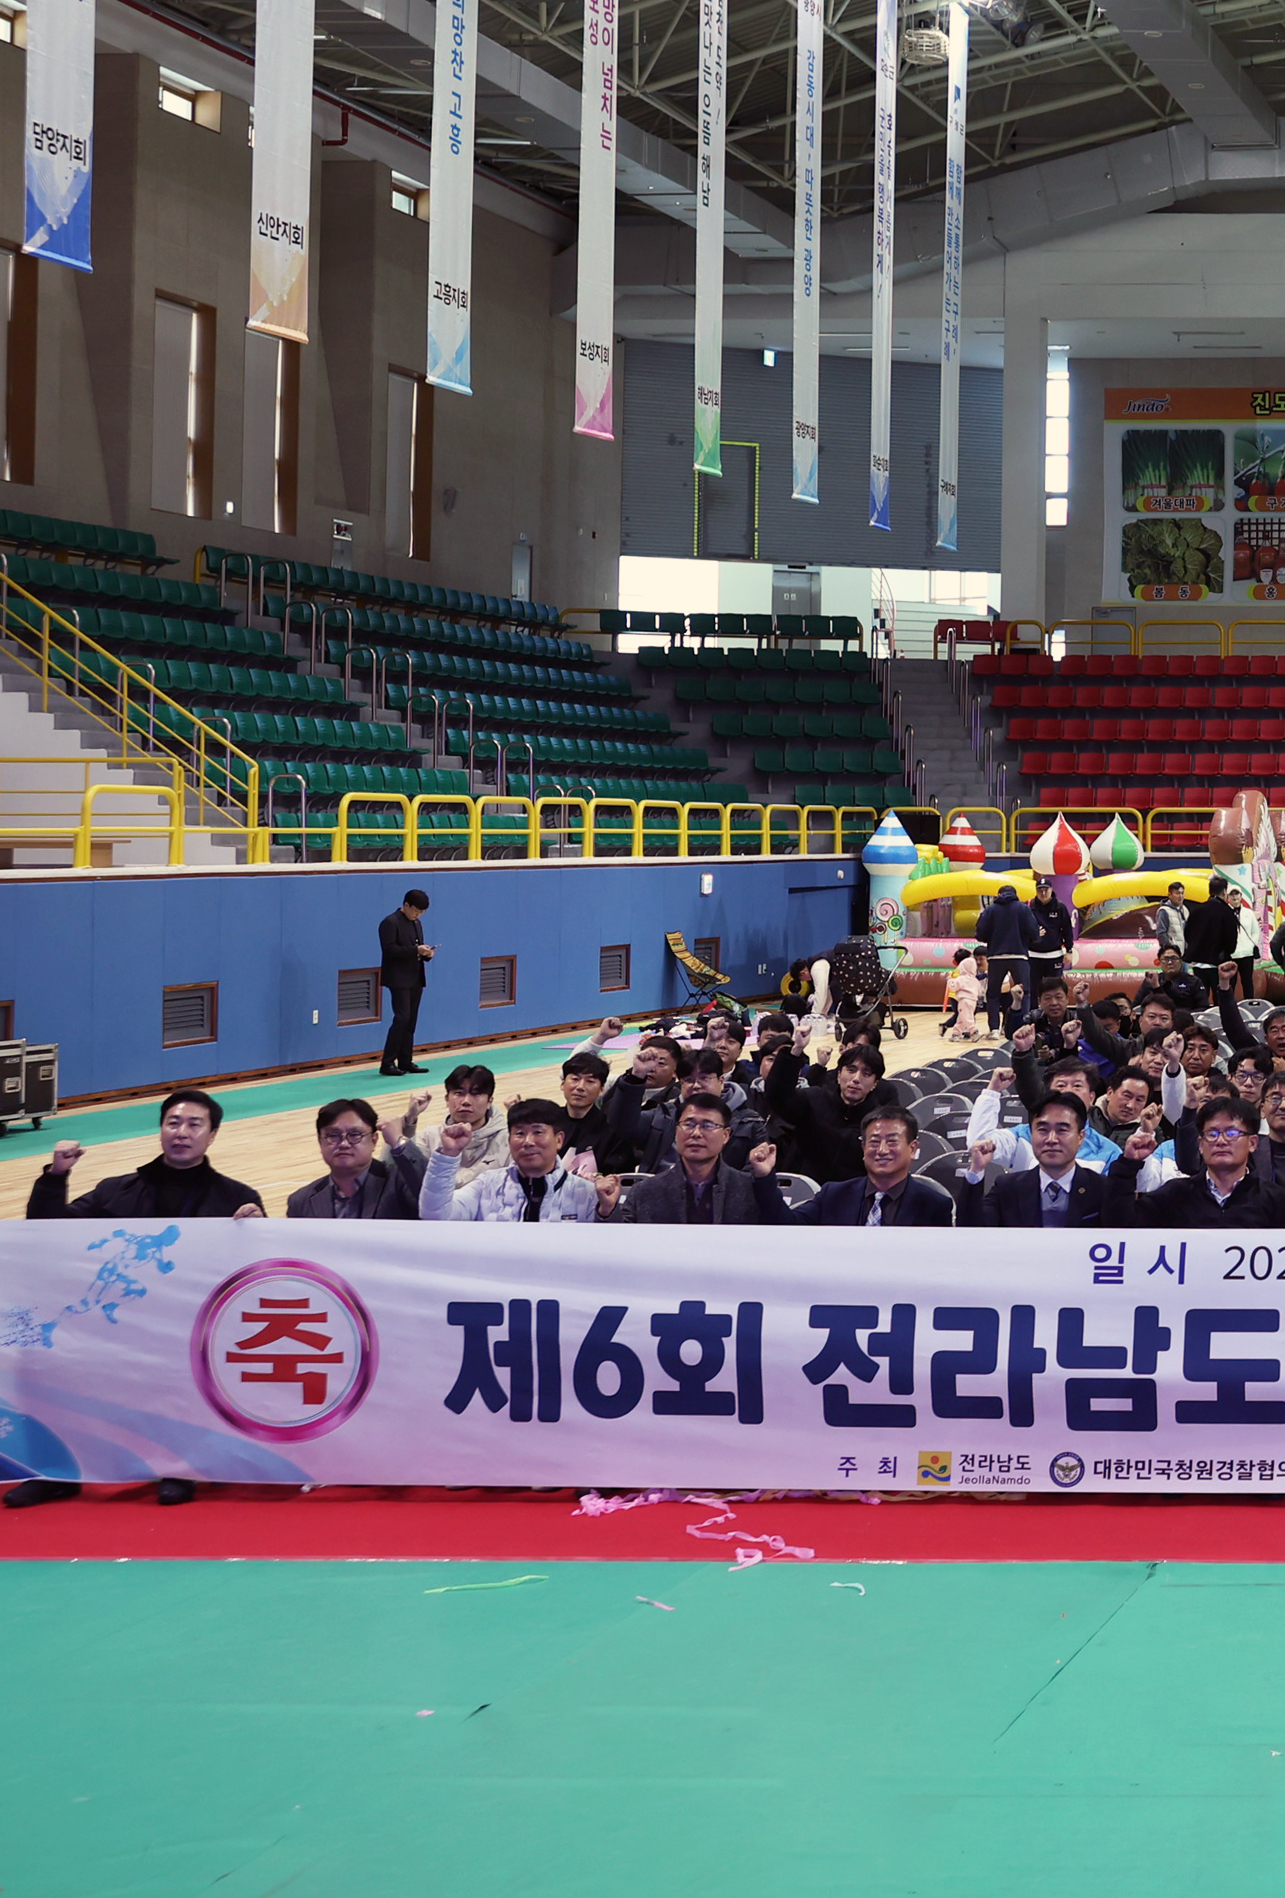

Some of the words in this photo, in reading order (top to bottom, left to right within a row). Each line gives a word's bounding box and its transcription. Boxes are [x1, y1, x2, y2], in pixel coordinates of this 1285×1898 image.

[449, 90, 462, 155] 고흥
[600, 61, 614, 151] 넘치는
[702, 93, 712, 147] 으뜸
[32, 121, 87, 167] 담양지회
[701, 153, 711, 208] 해남
[948, 158, 955, 201] 함께
[955, 163, 963, 206] 함께
[804, 167, 814, 242] 따뜻한
[257, 212, 304, 250] 신안지회
[804, 249, 813, 298] 광양
[952, 212, 961, 297] 소통하는
[432, 280, 469, 312] 고흥지회
[579, 339, 610, 366] 보성지회
[697, 385, 720, 409] 해남지회
[795, 420, 817, 442] 광양지회
[872, 454, 889, 472] 화순지회
[940, 478, 956, 498] 구례지회
[1150, 498, 1196, 510] 겨울대파
[226, 1297, 345, 1406] 축
[443, 1298, 764, 1425] 제6회
[958, 1452, 1032, 1474] 전라남도
[958, 1474, 1032, 1486] JeollaNamdo
